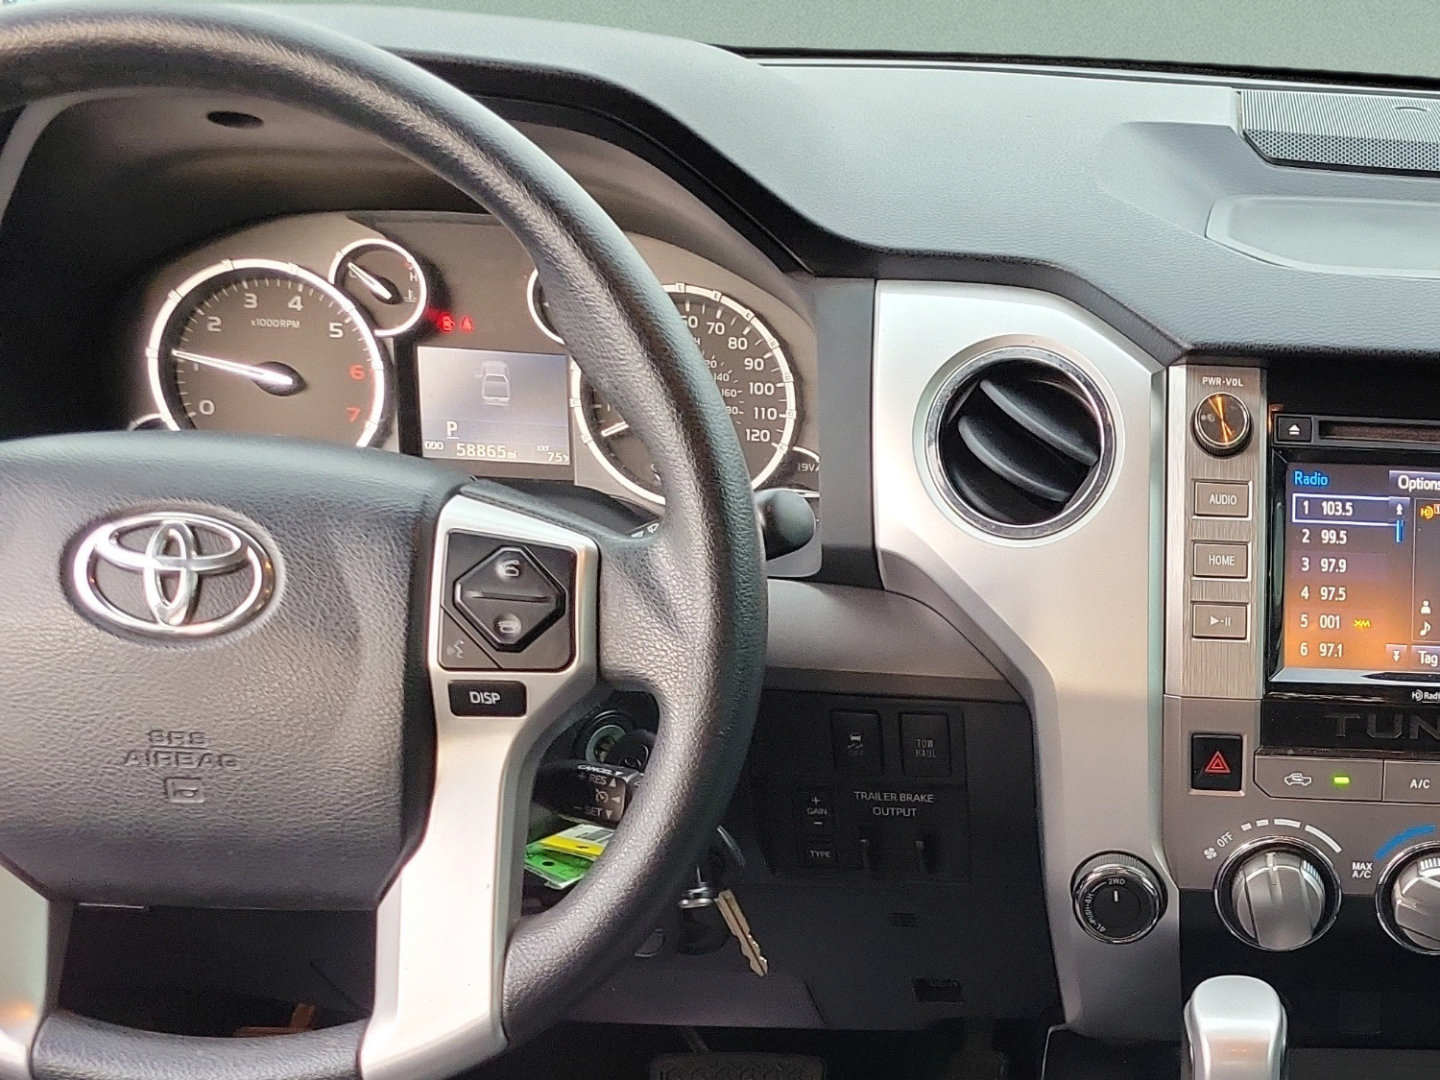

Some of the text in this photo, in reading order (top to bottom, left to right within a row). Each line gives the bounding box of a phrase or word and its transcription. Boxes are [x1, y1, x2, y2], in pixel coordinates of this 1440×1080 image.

[243, 293, 258, 309] 3
[288, 295, 303, 311] 4
[207, 316, 222, 332] 2
[329, 322, 344, 338] 5
[706, 322, 726, 335] 70
[728, 337, 748, 350] 80
[744, 358, 765, 371] 90
[350, 366, 364, 380] 6
[749, 382, 775, 396] 100
[200, 399, 216, 416] 0
[347, 407, 360, 422] 7
[754, 407, 778, 420] 110
[446, 421, 458, 436] P
[746, 429, 771, 443] 120
[1293, 470, 1329, 487] Radio
[1209, 493, 1238, 506] AUDIO
[1303, 500, 1354, 517] 1 103.5
[1301, 529, 1348, 545] 2 99.5
[1208, 553, 1236, 566] HOME
[1301, 558, 1347, 573] 3 97.9
[1300, 585, 1347, 602] 4 97.5
[1300, 614, 1309, 628] 5
[1319, 615, 1341, 630] 001
[1300, 642, 1344, 658] 6 97.1
[1418, 651, 1439, 667] Tag
[469, 692, 501, 705] DISP
[1410, 778, 1431, 790] A/C
[853, 791, 935, 804] TRAILER BRAKE
[806, 807, 829, 816] GAIN
[872, 806, 918, 817] OUTPUT
[1216, 831, 1234, 848] OFF
[810, 850, 831, 858] TYPE
[1352, 862, 1373, 871] MAX
[1352, 871, 1372, 880] A/C
